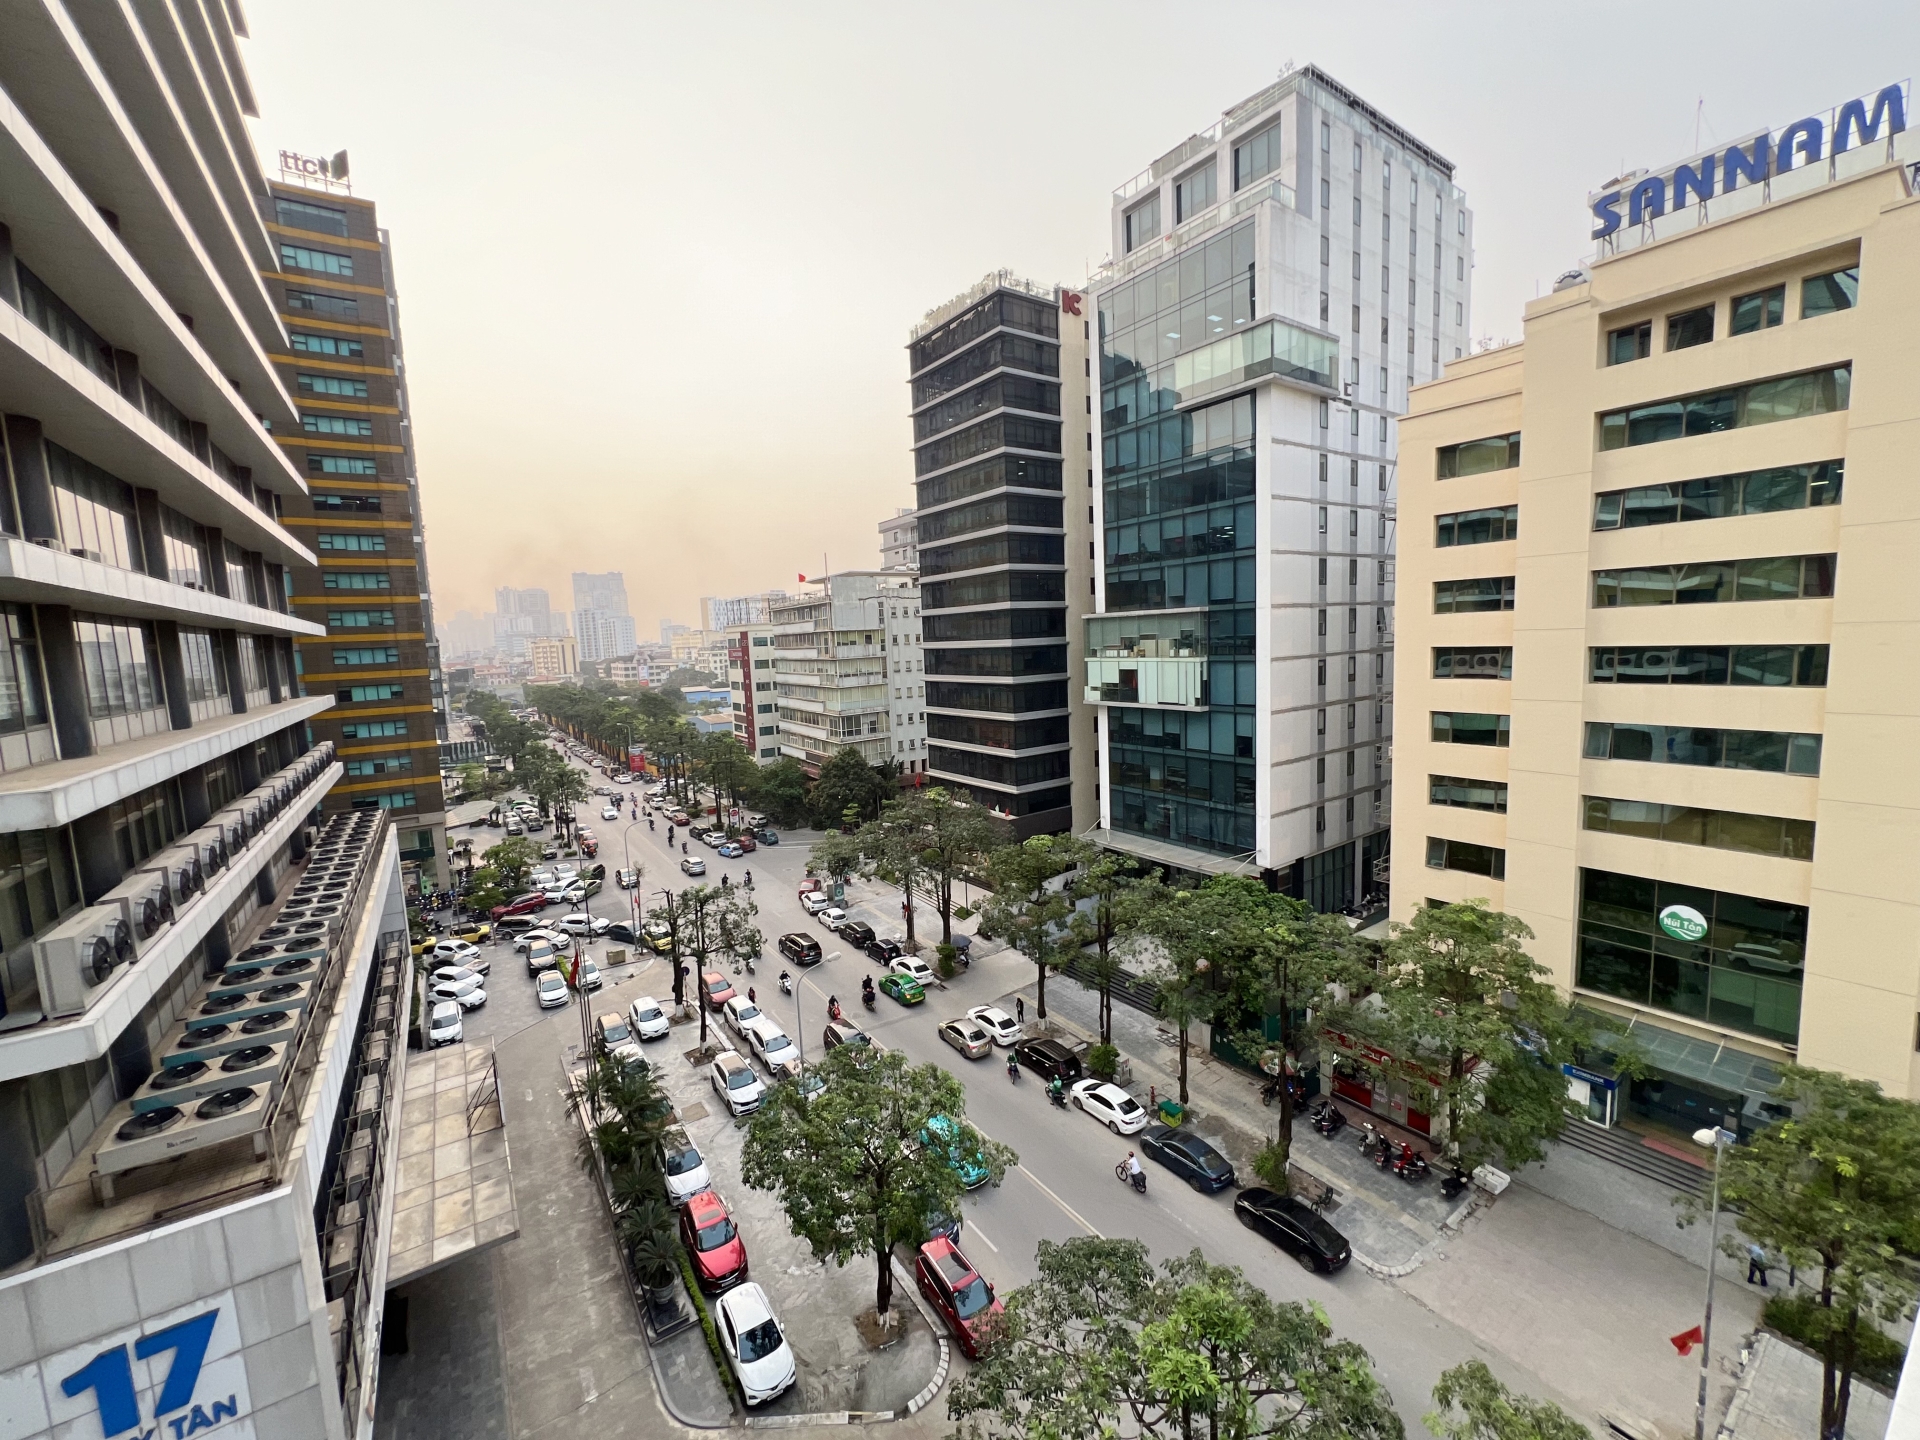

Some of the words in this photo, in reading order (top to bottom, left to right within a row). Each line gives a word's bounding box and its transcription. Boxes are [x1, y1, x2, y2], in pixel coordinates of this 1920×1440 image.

[281, 150, 318, 175] ttc
[1591, 83, 1906, 240] SANNAM
[61, 1308, 220, 1439] 17
[168, 1394, 238, 1440] TÂN
